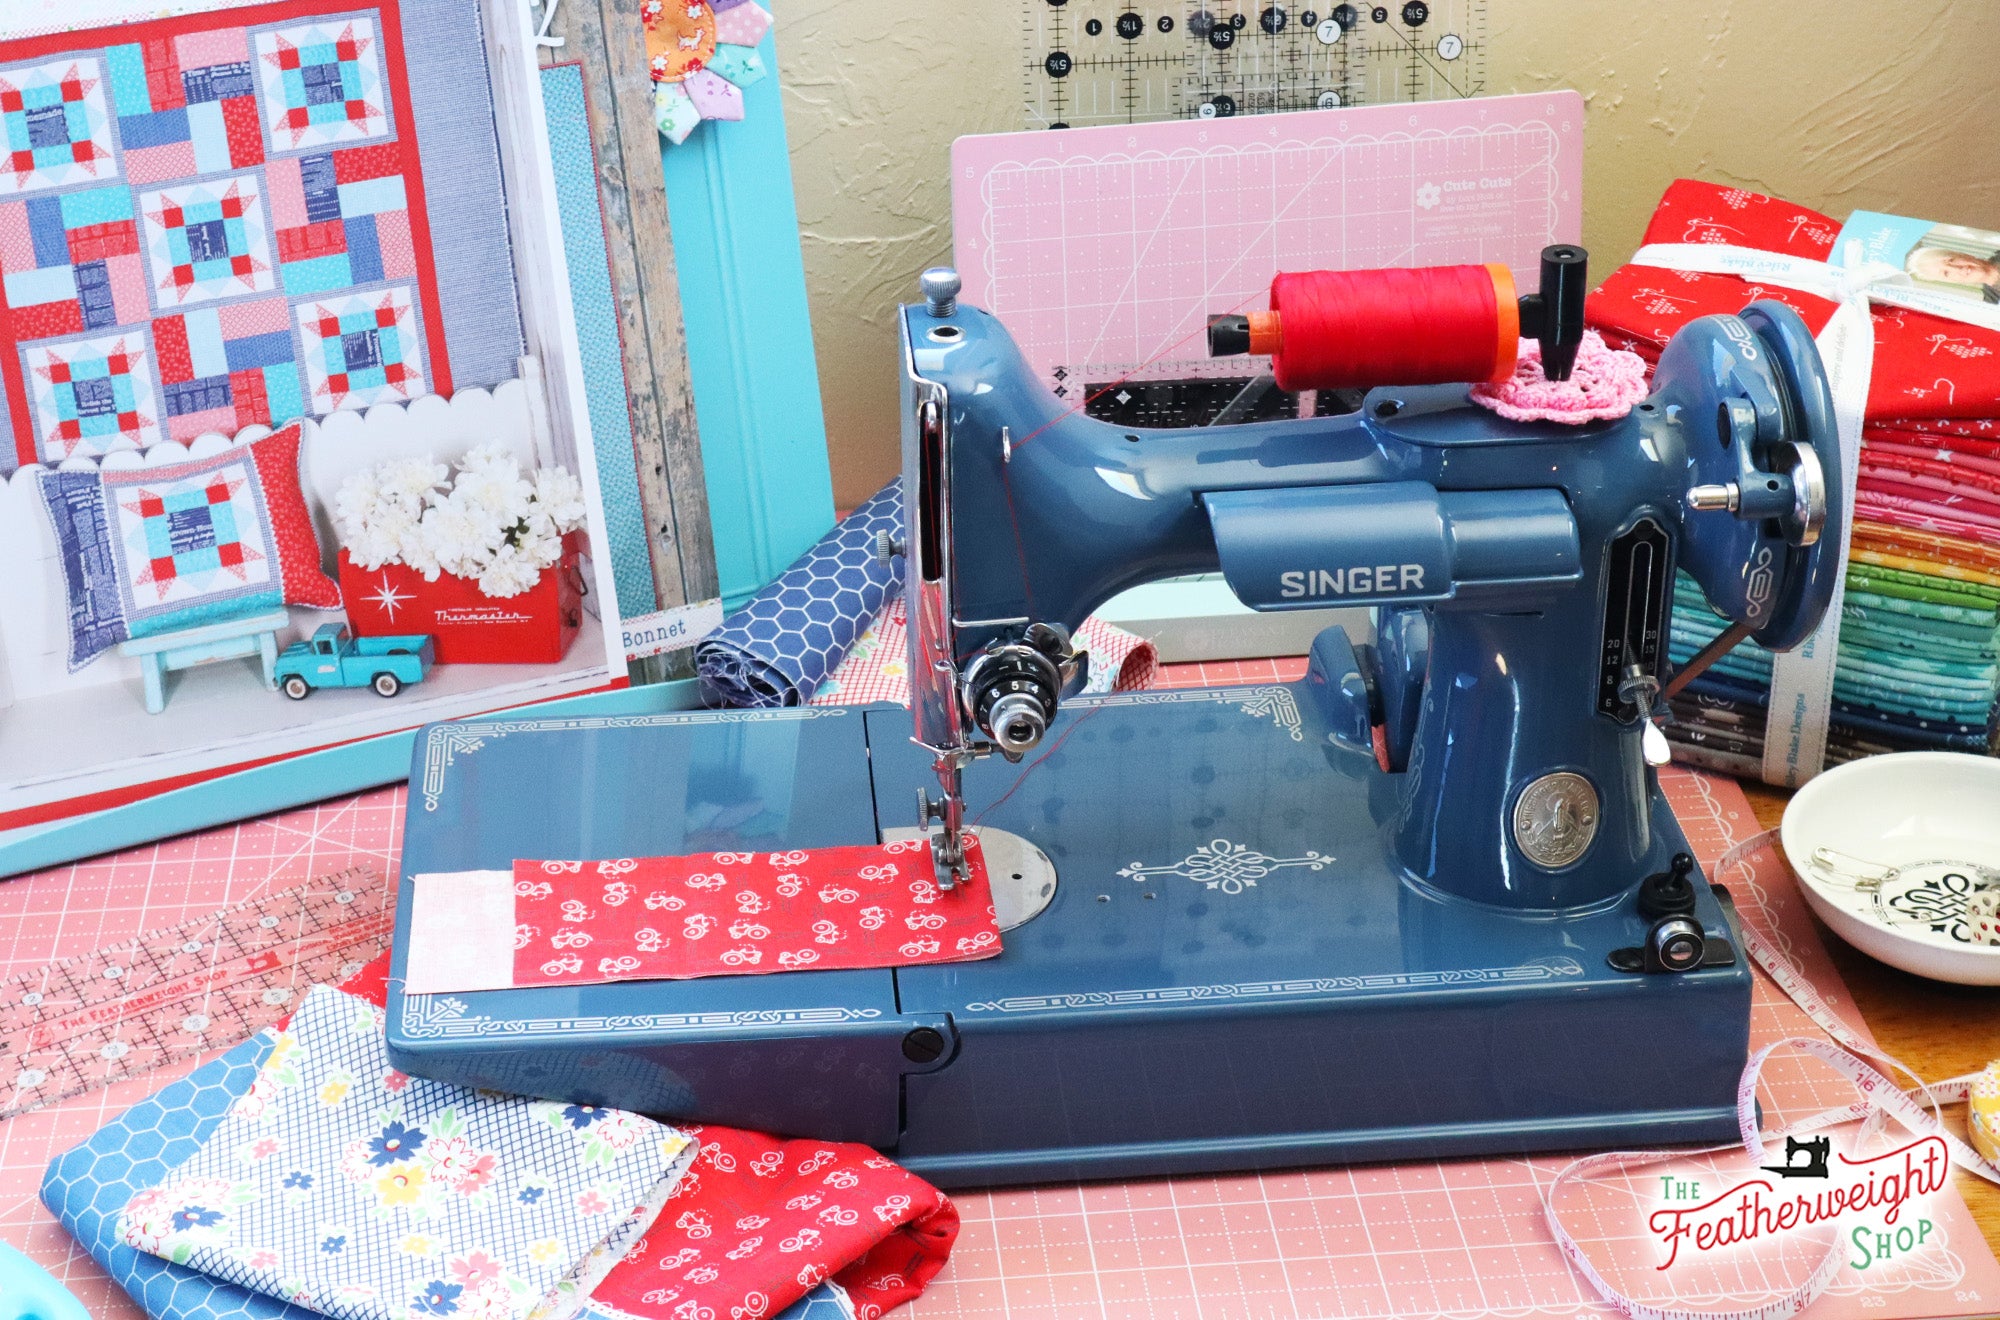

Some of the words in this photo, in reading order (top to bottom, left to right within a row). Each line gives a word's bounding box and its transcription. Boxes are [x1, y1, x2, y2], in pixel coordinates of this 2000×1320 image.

[1443, 178, 1476, 193] Cute
[1480, 177, 1512, 190] Cuts
[1281, 563, 1425, 598] SINGER
[434, 610, 533, 622] Thermaster
[622, 619, 687, 648] Bonnet
[1607, 639, 1620, 649] 20
[1606, 655, 1619, 665] 12
[59, 1014, 88, 1031] THE
[89, 982, 191, 1022] FEATHERWEIGHT
[193, 970, 229, 988] SHOP
[1855, 1072, 1876, 1092] 16
[1794, 1292, 1812, 1313] 37
[1954, 1291, 1982, 1303] 24
